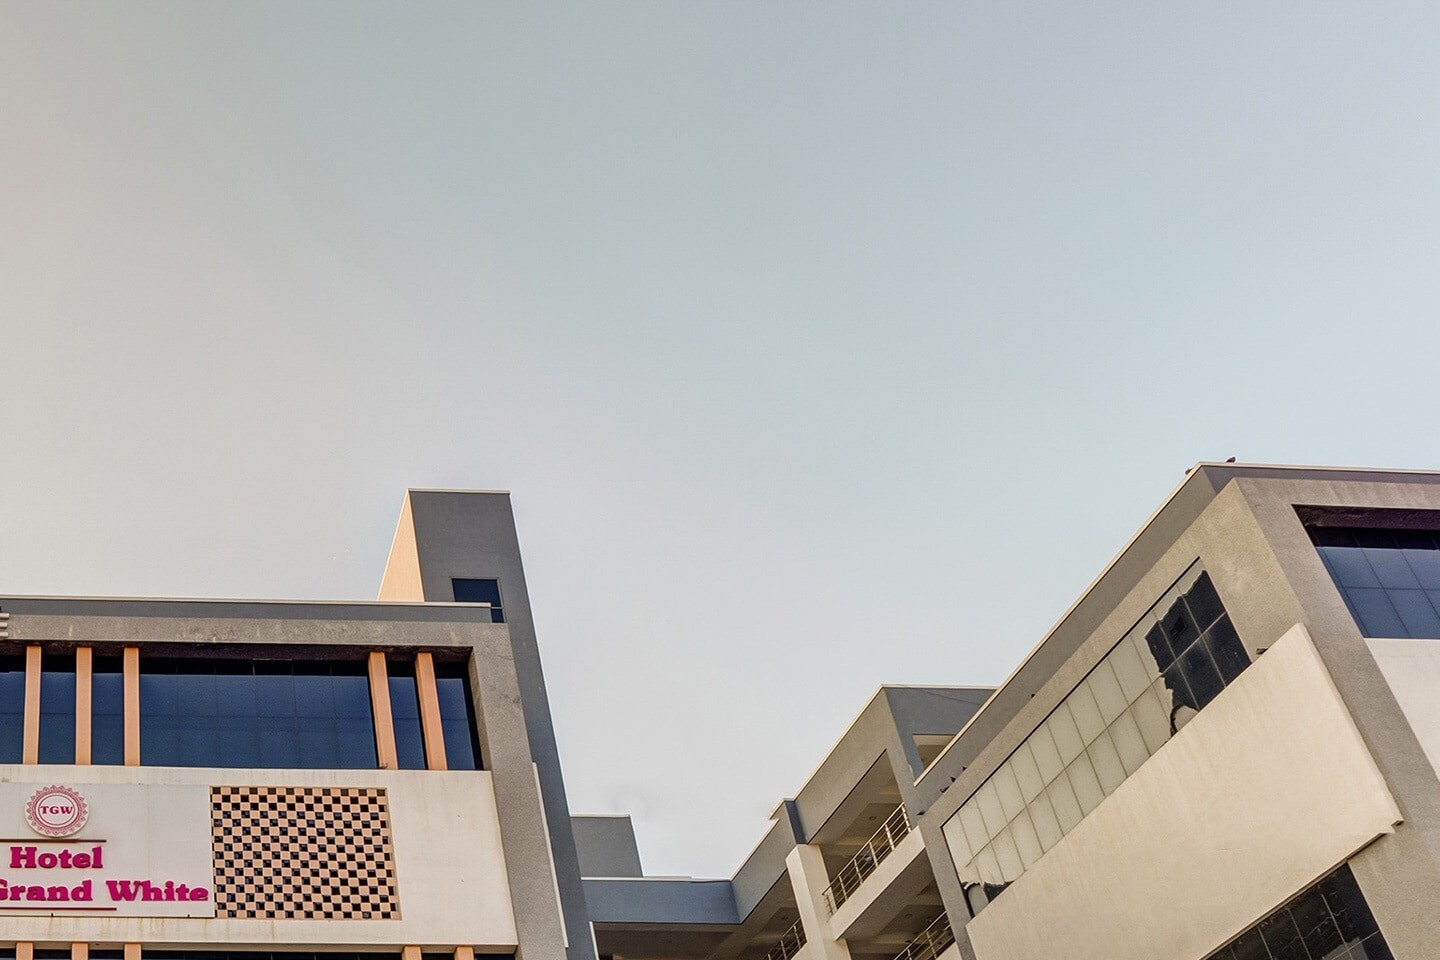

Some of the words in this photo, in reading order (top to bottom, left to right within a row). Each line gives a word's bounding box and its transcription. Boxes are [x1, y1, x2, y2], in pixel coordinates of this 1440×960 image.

[40, 804, 74, 816] TGW
[9, 846, 104, 869] Hotel
[105, 880, 209, 902] White
